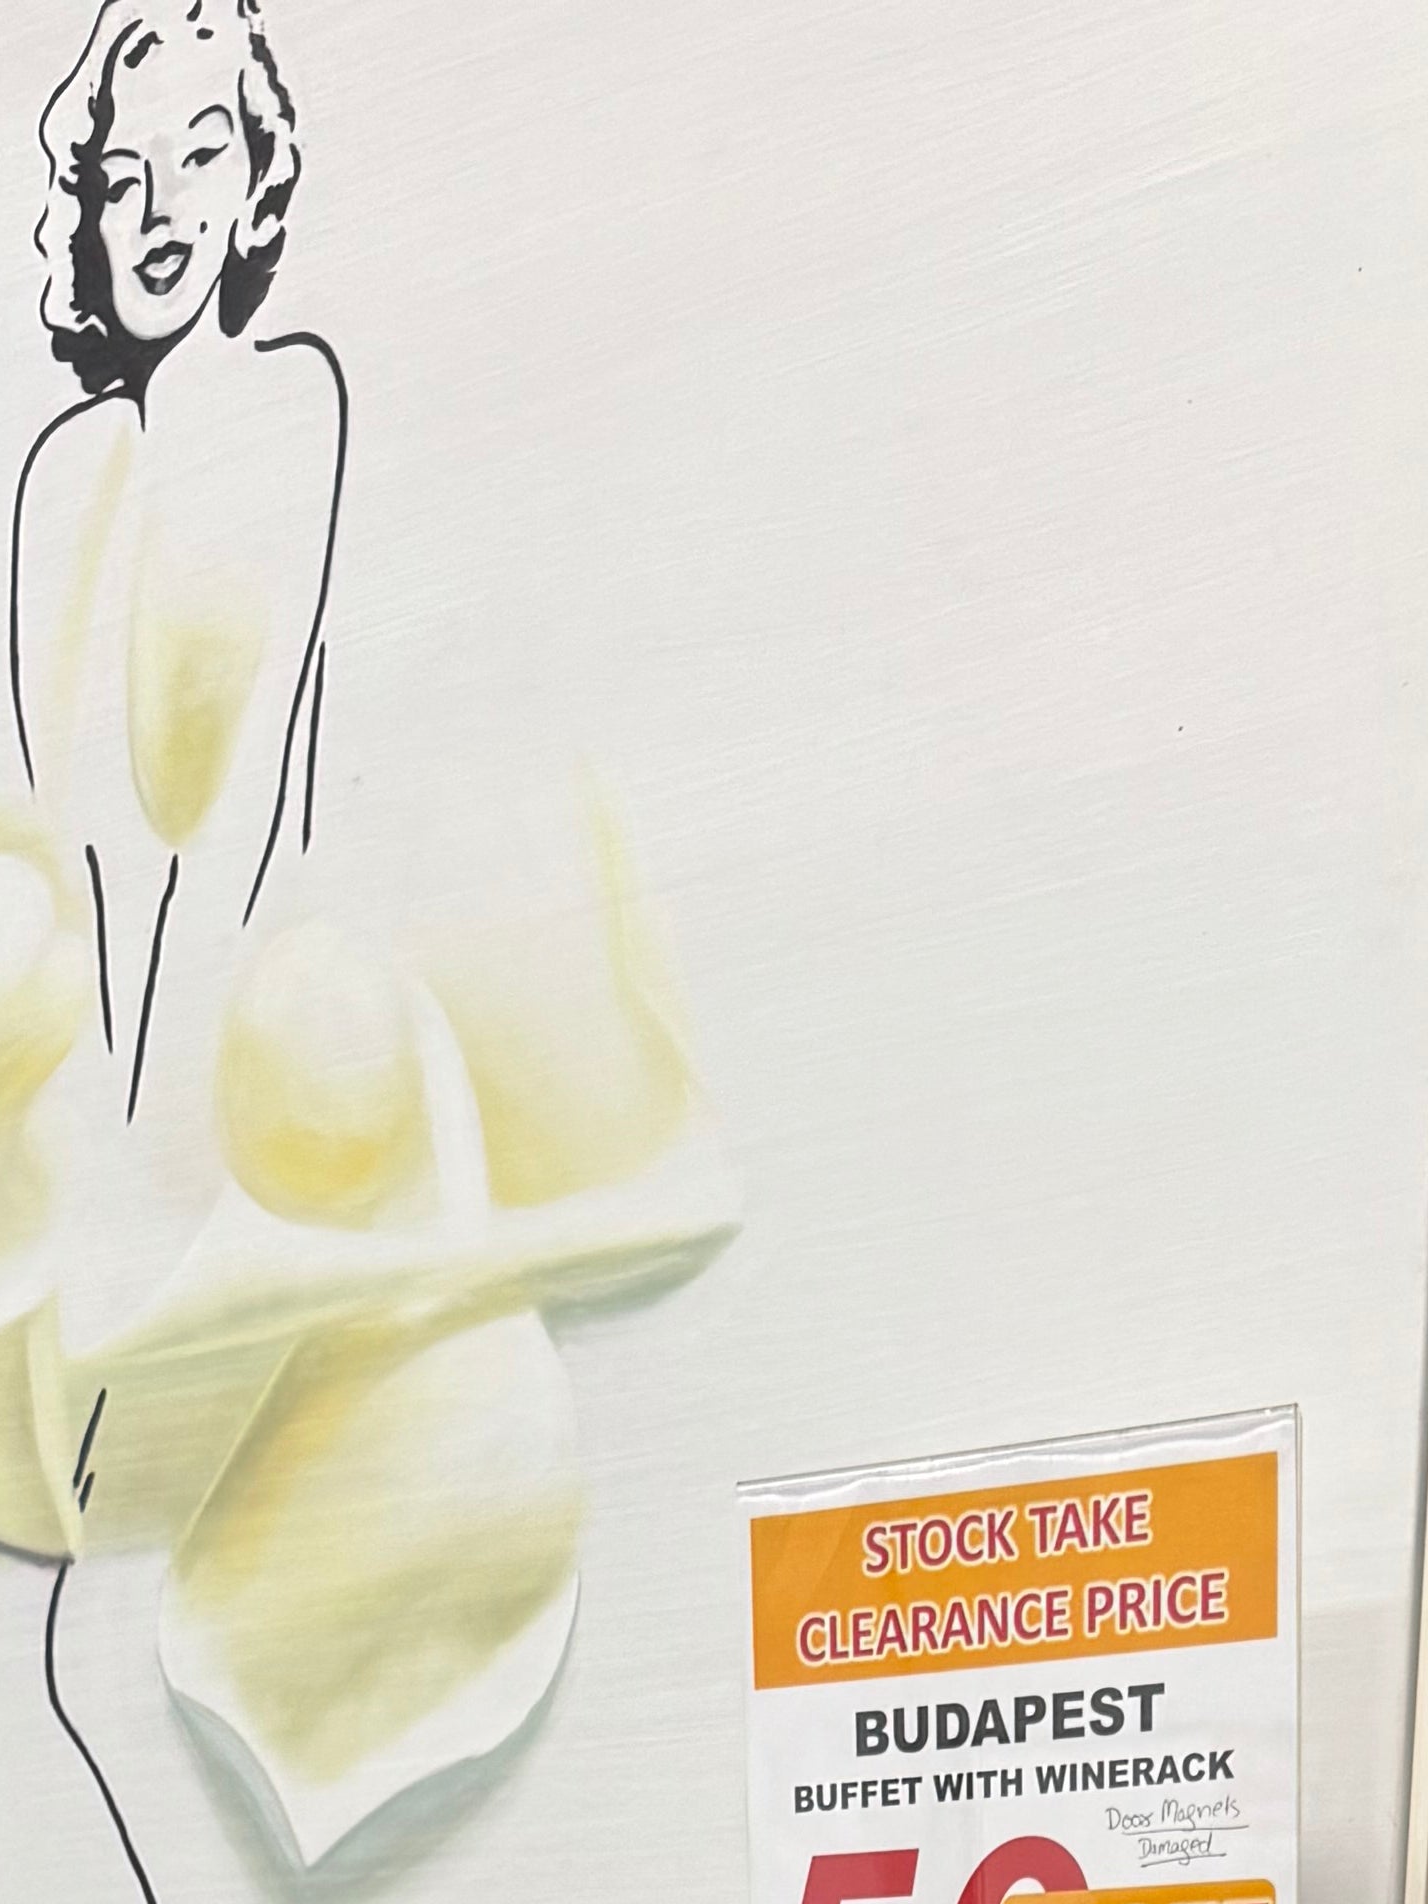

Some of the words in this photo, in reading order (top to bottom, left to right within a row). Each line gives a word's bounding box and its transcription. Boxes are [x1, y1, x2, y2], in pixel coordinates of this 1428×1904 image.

[865, 1511, 1015, 1574] STOCK
[1029, 1494, 1150, 1555] TAKE
[799, 1590, 1070, 1663] CLEARANCE
[1085, 1572, 1226, 1634] PRICE
[855, 1683, 1165, 1757] BUDAPEST
[794, 1777, 922, 1813] BUFFET
[933, 1768, 1023, 1802] WITH
[1035, 1749, 1235, 1794] WINERACK
